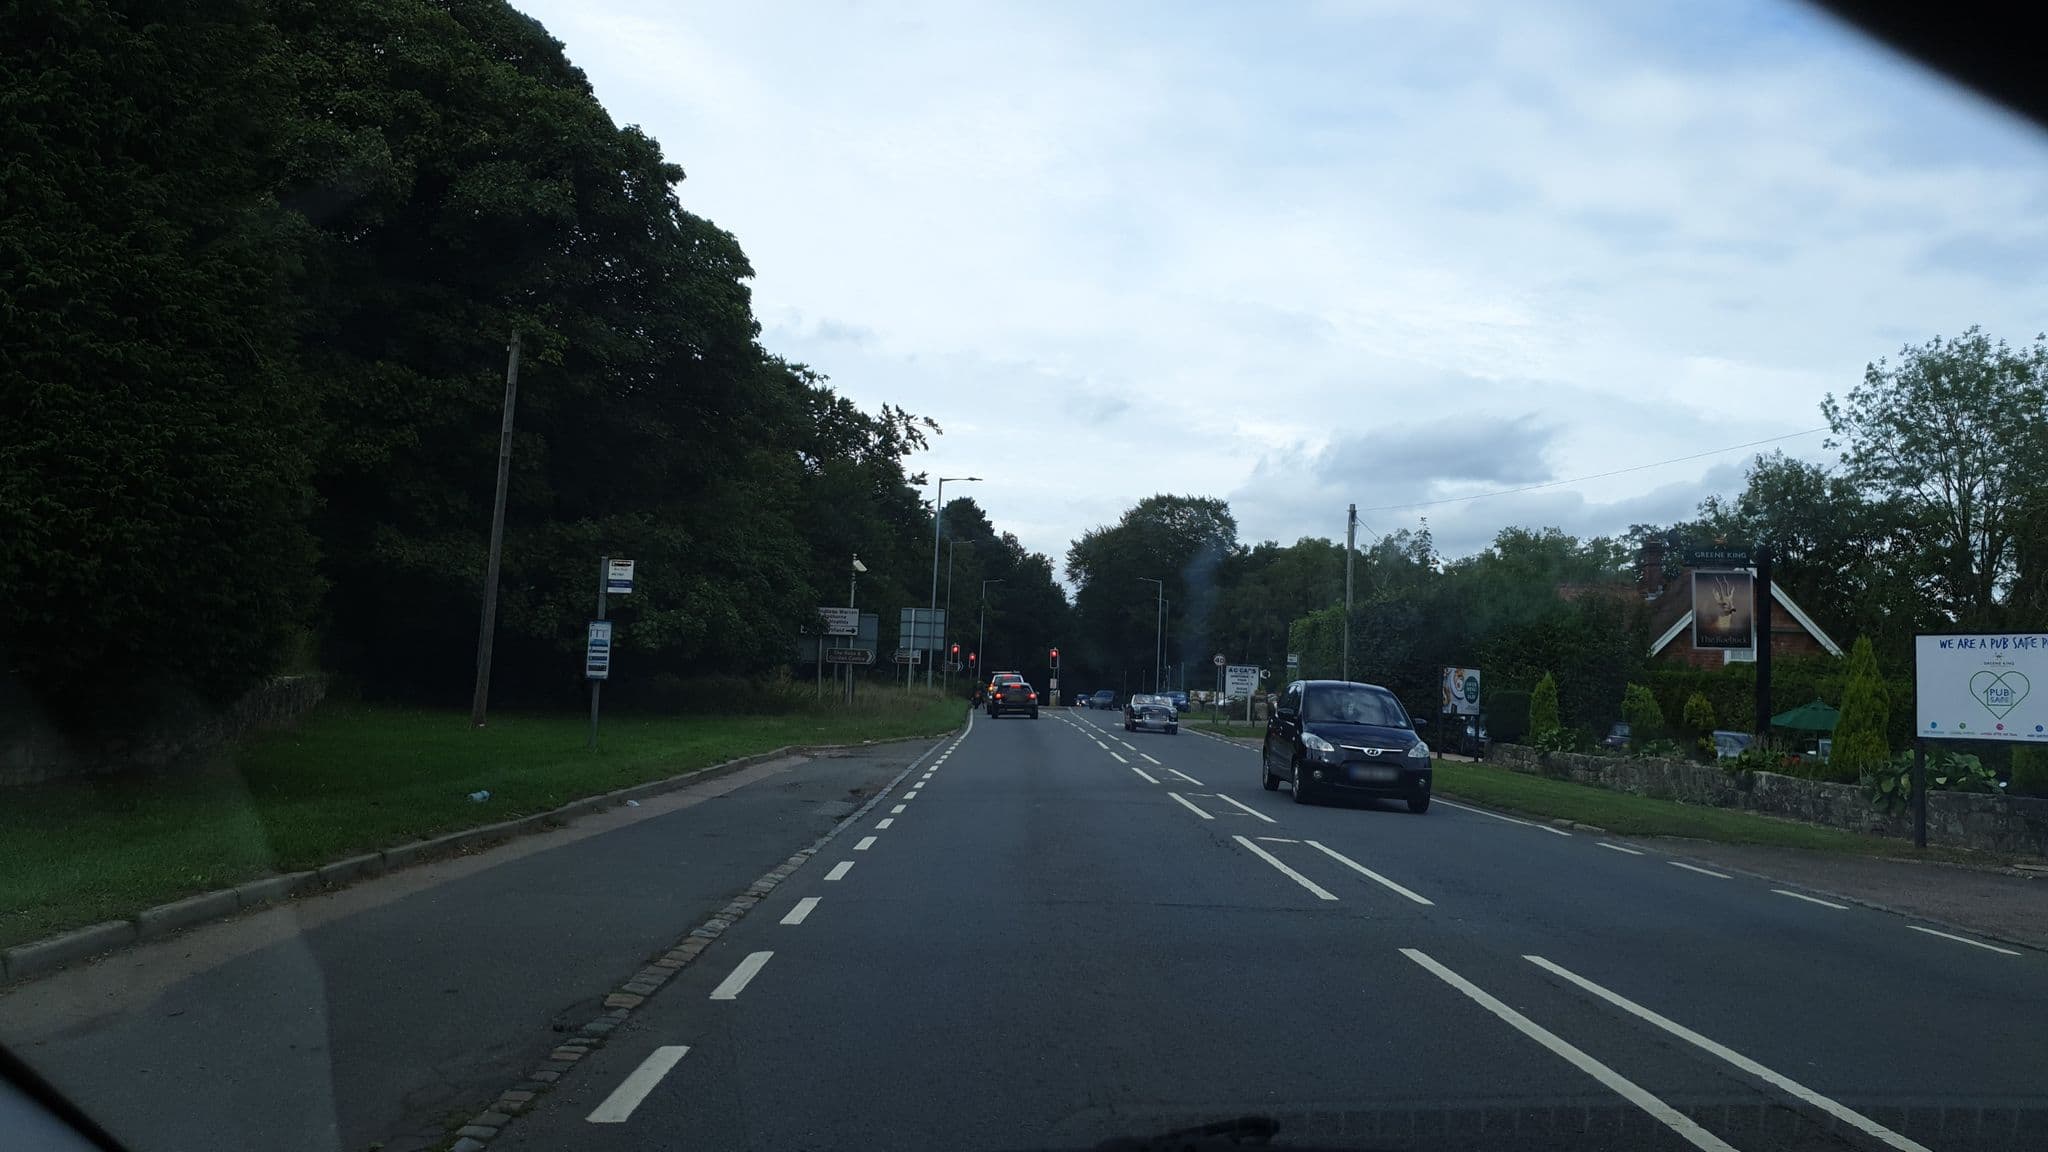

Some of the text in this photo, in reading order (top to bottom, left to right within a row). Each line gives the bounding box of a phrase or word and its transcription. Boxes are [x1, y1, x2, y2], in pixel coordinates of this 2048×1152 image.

[1694, 551, 1747, 559] GREENE KING
[1939, 639, 1954, 649] WE
[1957, 638, 1976, 649] ARE
[1979, 638, 1986, 649] A
[1990, 637, 2008, 649] PUB
[2012, 636, 2038, 650] SAFE
[1989, 689, 2009, 697] PUB
